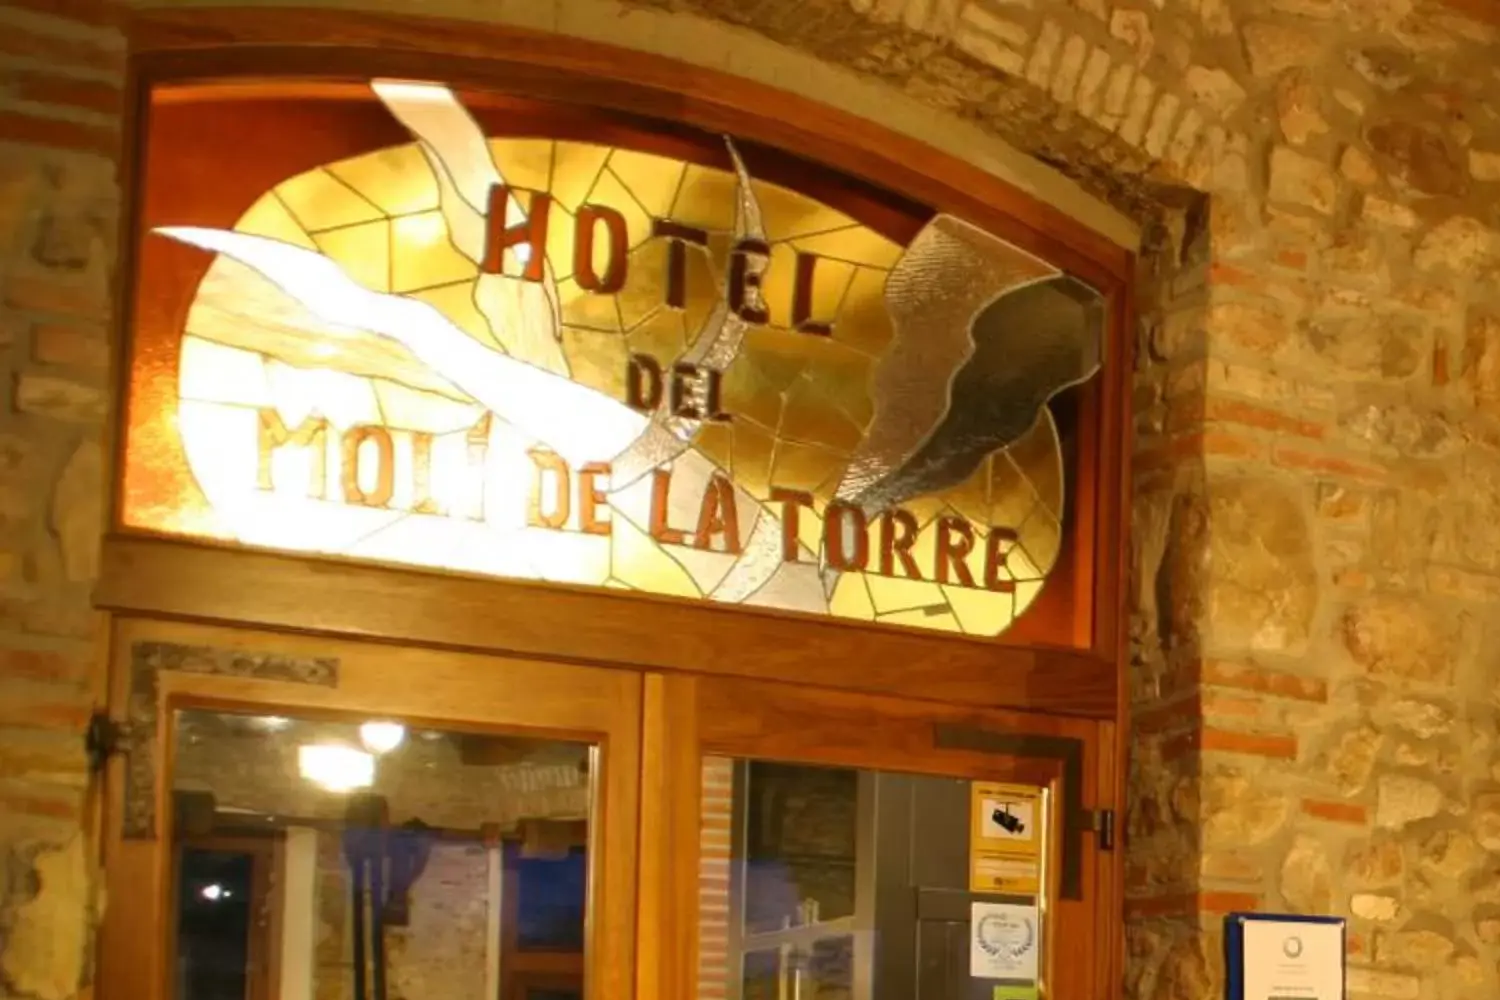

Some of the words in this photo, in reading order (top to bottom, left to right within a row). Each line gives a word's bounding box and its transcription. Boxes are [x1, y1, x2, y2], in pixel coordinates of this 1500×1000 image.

[481, 181, 835, 336] HOTEL
[626, 352, 734, 423] DEL
[526, 447, 614, 535] DE
[650, 464, 741, 555] LA
[769, 487, 1019, 593] TORRE
